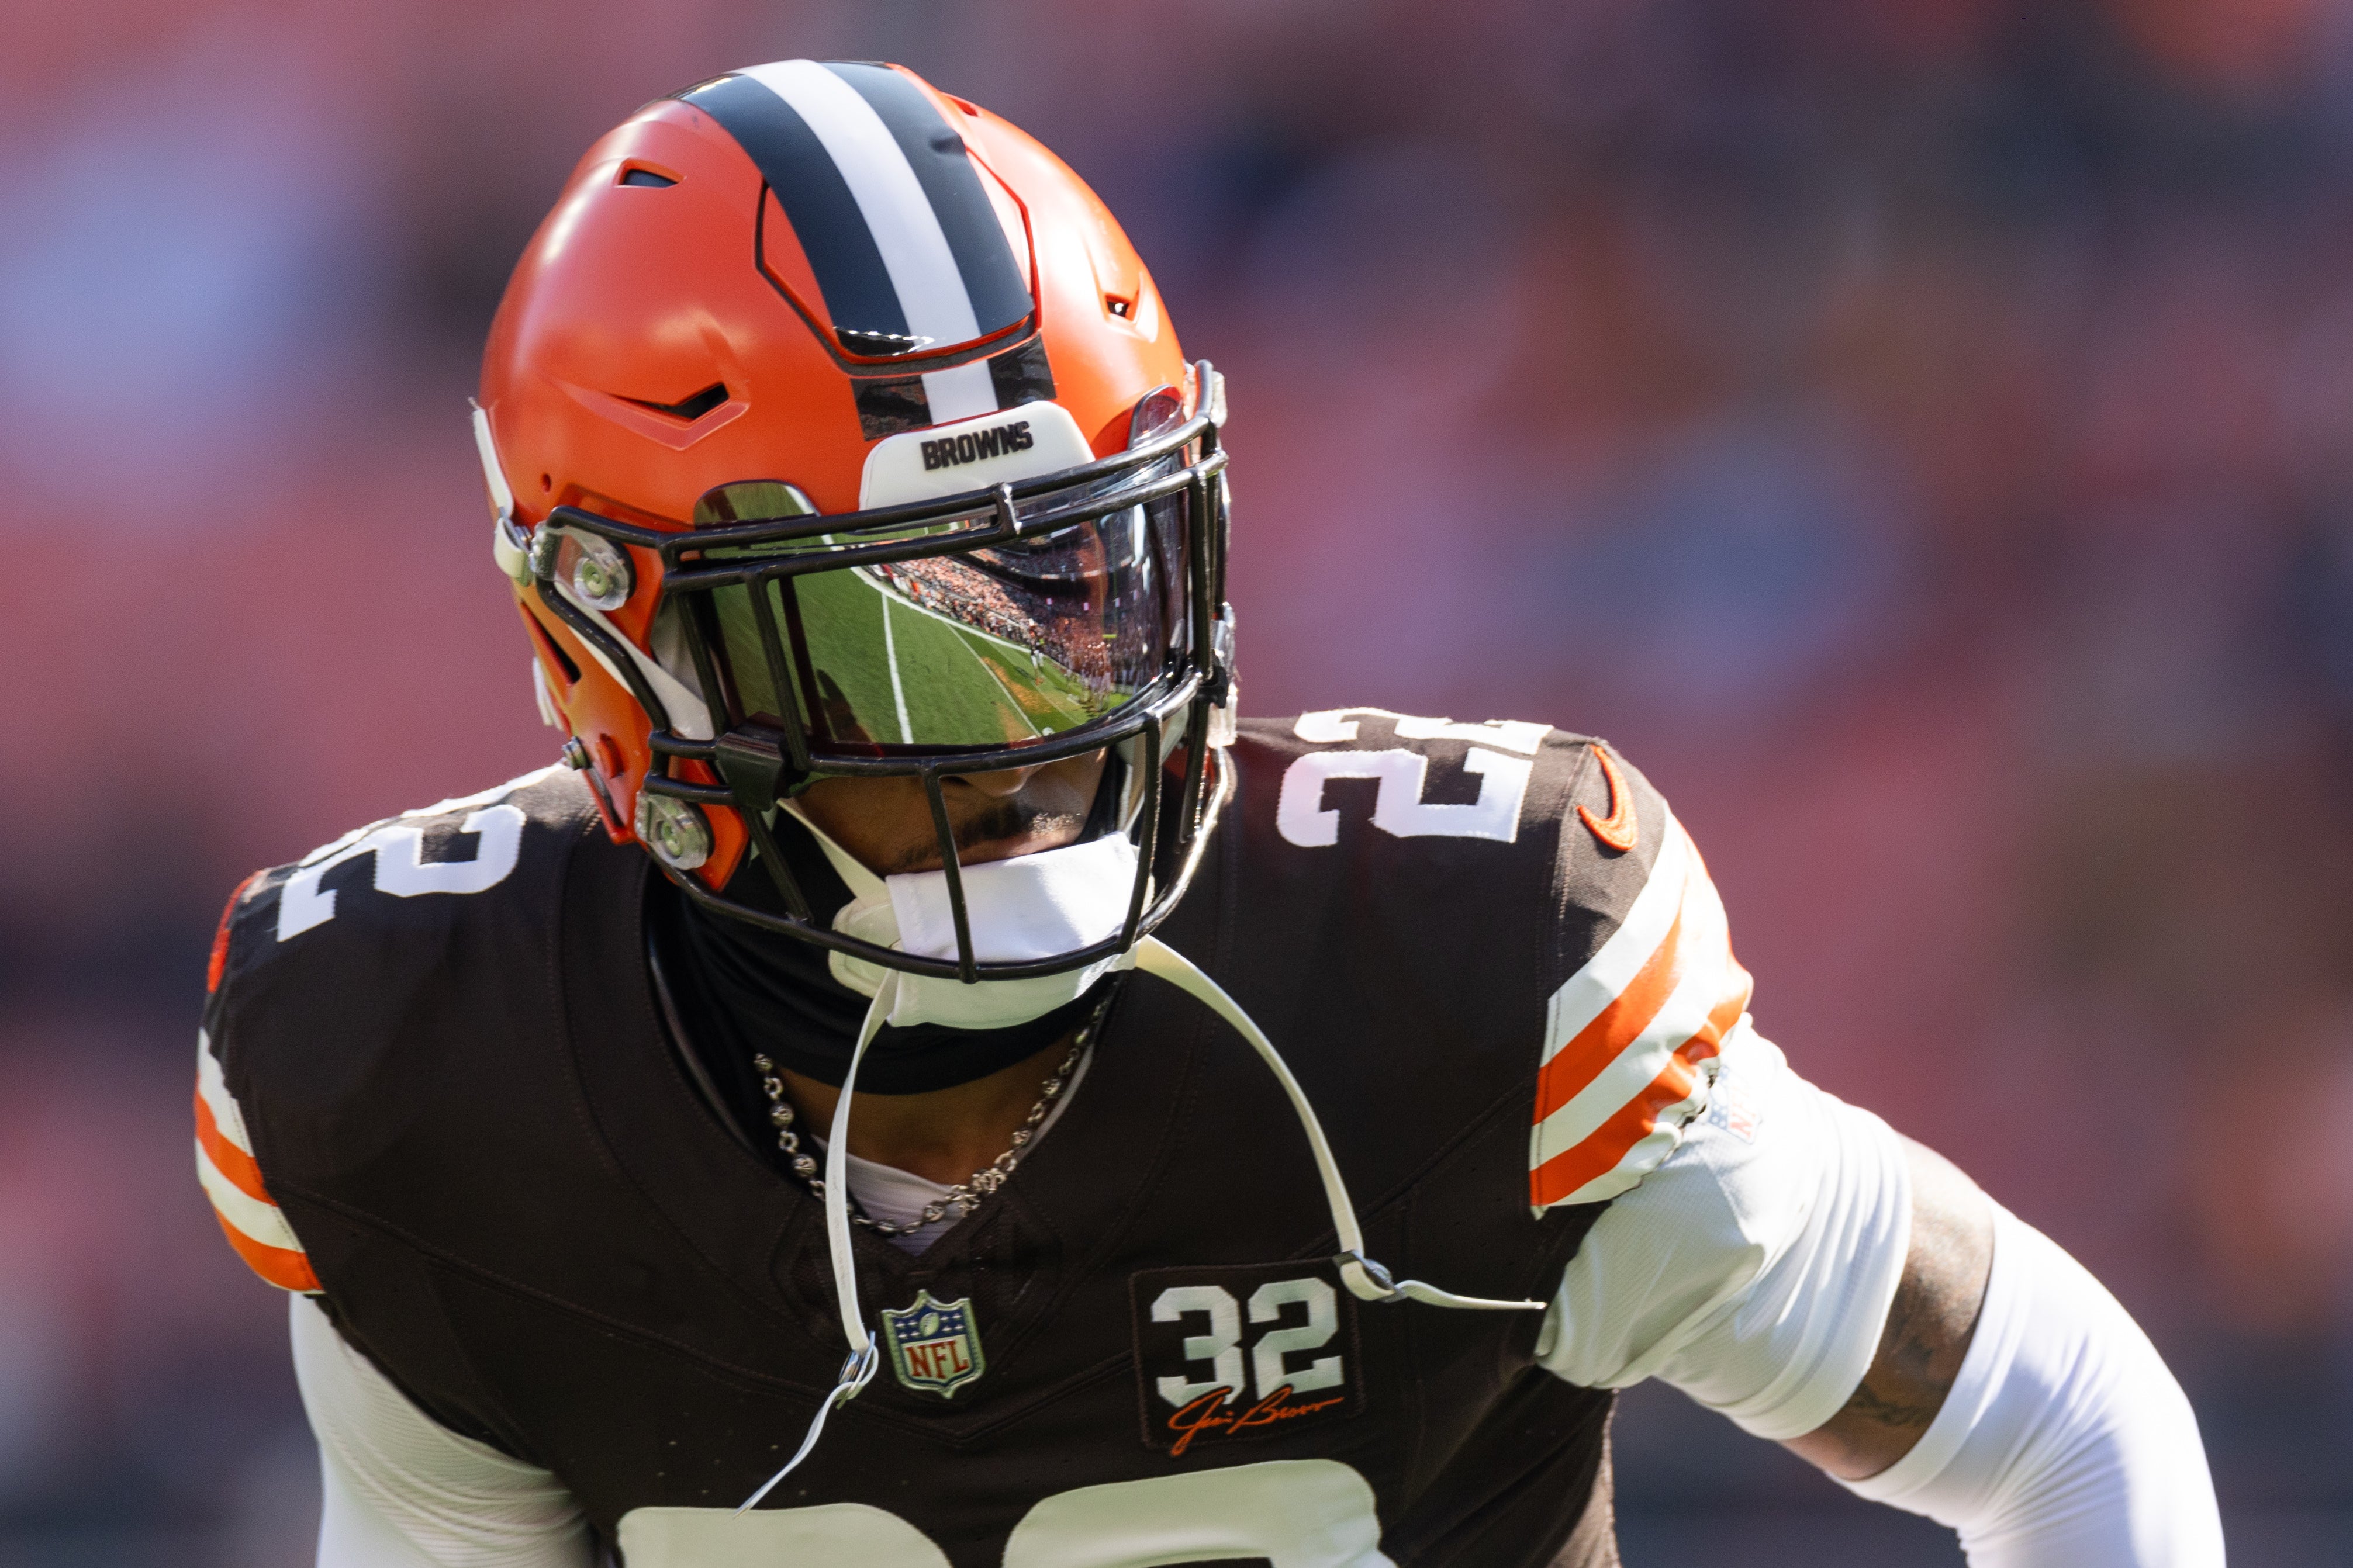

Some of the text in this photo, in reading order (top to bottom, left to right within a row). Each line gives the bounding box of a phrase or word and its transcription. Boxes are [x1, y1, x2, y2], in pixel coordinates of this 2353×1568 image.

[920, 421, 1034, 471] BROWNS
[277, 763, 565, 942] 2
[904, 1339, 969, 1379] NFL
[1150, 1277, 1344, 1408] 32
